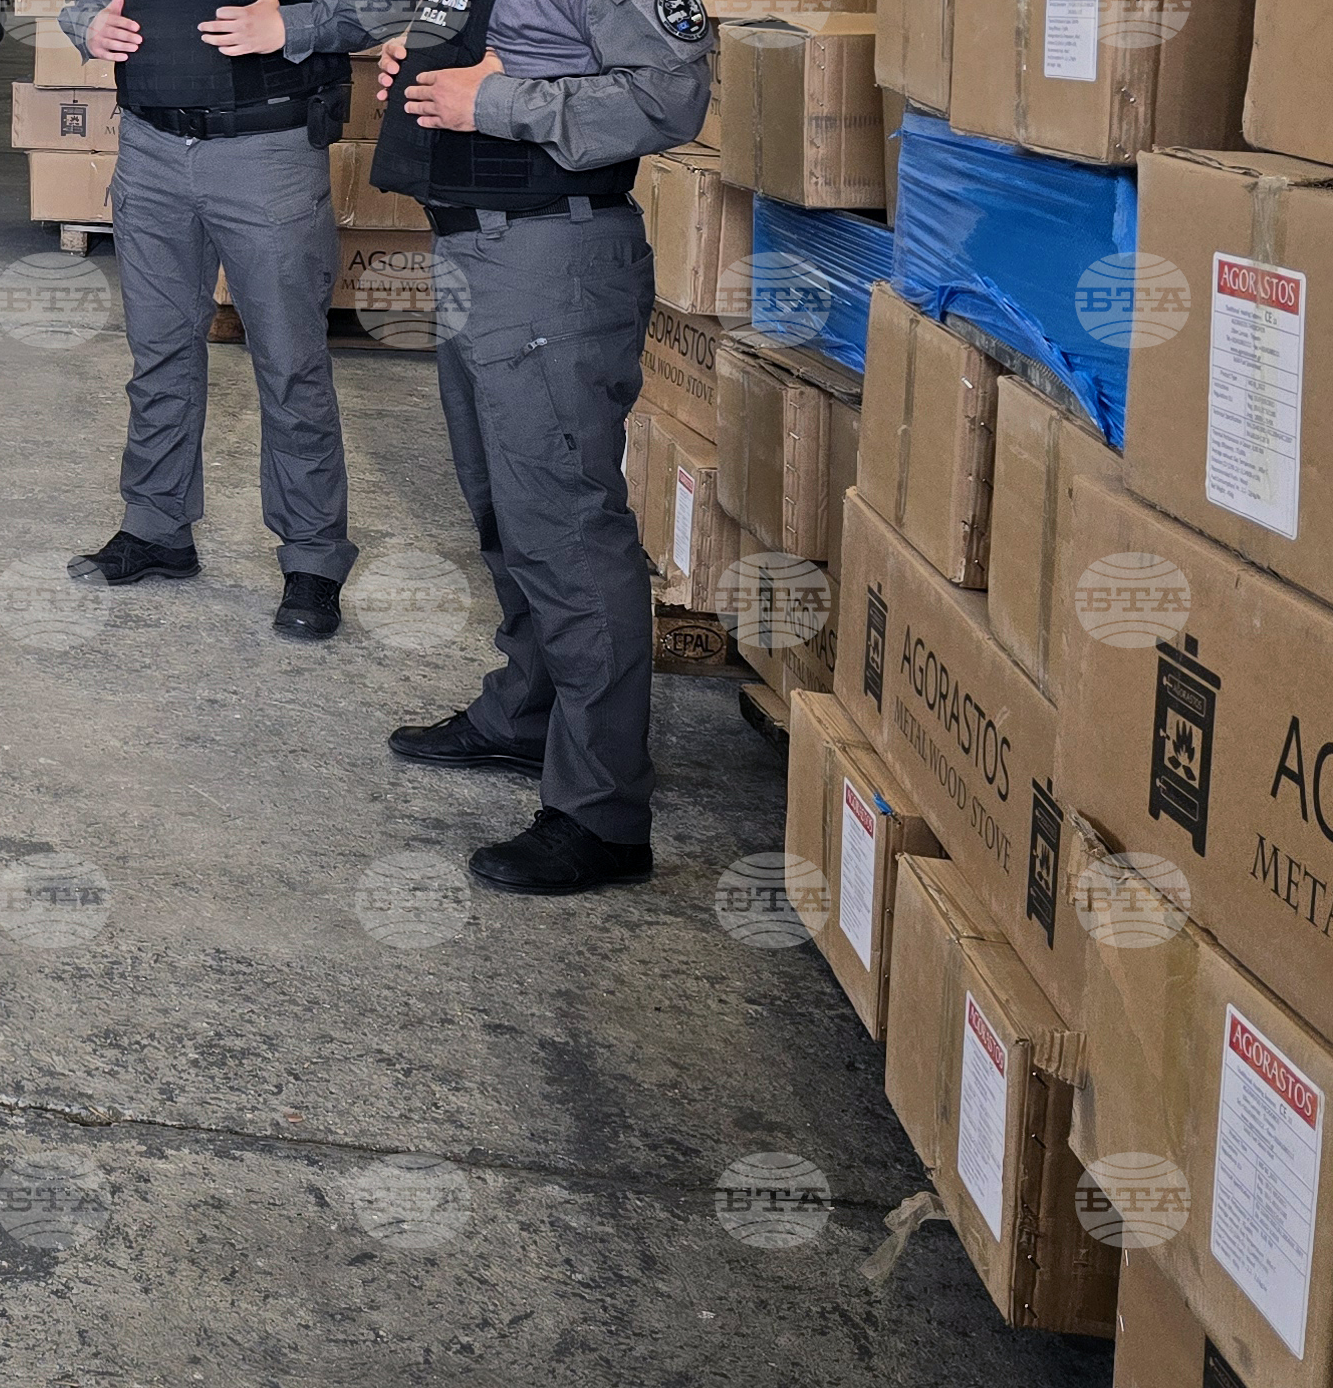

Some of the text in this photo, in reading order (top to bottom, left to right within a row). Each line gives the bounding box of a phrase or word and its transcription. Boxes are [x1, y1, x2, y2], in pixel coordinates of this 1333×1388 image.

[341, 278, 395, 293] METAL
[1220, 265, 1296, 306] AGORASTOS
[657, 356, 685, 388] WOOD
[686, 376, 715, 406] STOVE
[673, 632, 716, 654] EPAL
[900, 624, 1011, 802] AGORASTOS
[893, 695, 1012, 877] METAL WOOD STOVE
[1233, 1024, 1312, 1117] AGORASTOS
